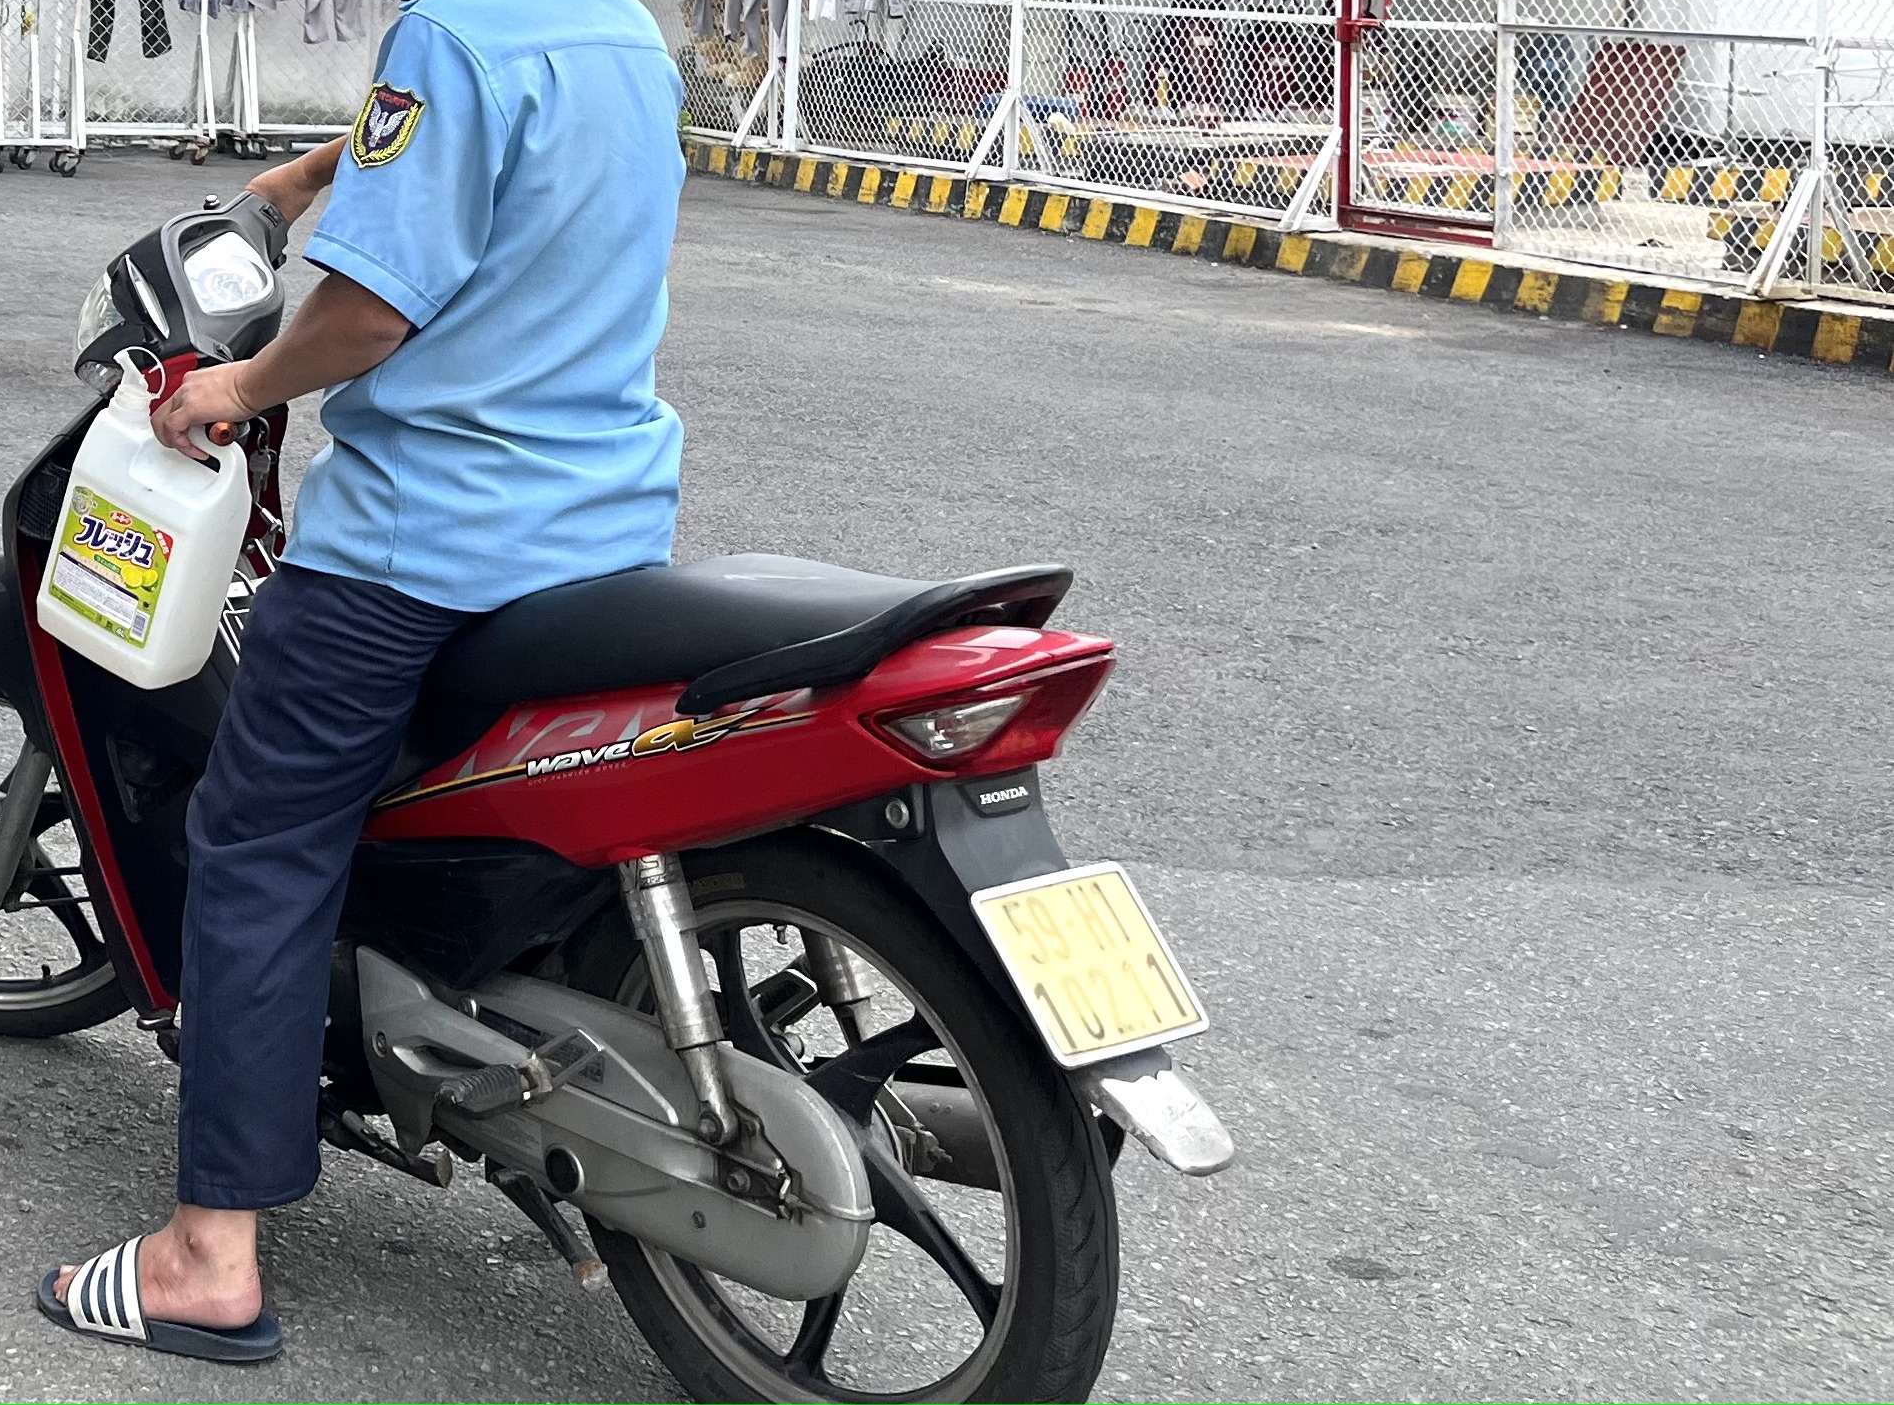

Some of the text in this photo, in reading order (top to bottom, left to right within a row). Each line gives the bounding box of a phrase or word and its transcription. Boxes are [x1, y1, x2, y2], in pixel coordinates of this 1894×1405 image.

[74, 514, 154, 568] フレッシュ
[979, 786, 1029, 804] HONDA
